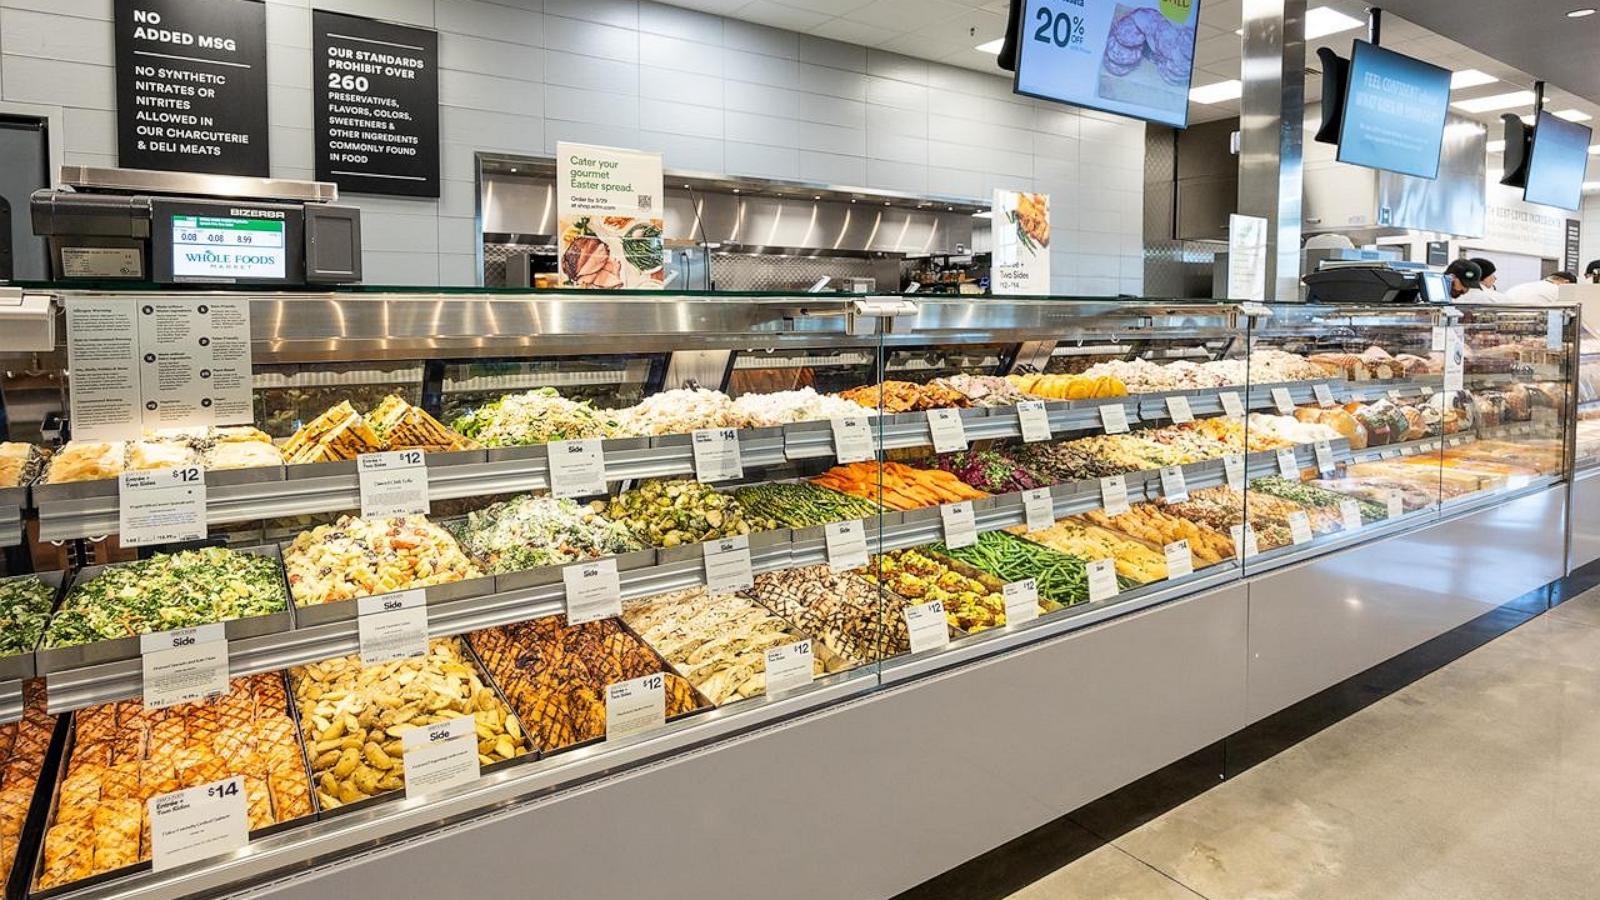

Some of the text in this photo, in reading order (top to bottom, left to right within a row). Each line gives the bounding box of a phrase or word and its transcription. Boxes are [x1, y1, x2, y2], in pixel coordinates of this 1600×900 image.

[133, 10, 160, 24] NO
[133, 26, 236, 51] ADDED MSG
[1070, 34, 1084, 43] OFF
[328, 46, 424, 69] OUR STANDARDS
[135, 65, 226, 85] NO SYNTHETIC
[328, 58, 415, 79] PROHIBIT OVER
[136, 81, 215, 98] NITRATES OR
[328, 73, 369, 92] 260
[136, 96, 191, 110] NITRITES
[328, 91, 400, 108] PRESERVATIVES,
[136, 110, 213, 126] ALLOWED IN
[329, 104, 412, 121] FLAVORS, COLORS,
[329, 116, 395, 130] SWEETENERS &
[136, 125, 249, 144] OUR CHARCUTERIE
[329, 128, 419, 144] OTHER INGREDIENTS
[137, 140, 221, 156] & DELI MEATS
[329, 140, 416, 156] COMMONLY FOUND
[329, 153, 369, 164] IN FOOD
[570, 155, 619, 169] Cater your
[570, 169, 610, 180] gourmet
[571, 179, 634, 192] Easter spread.
[230, 208, 285, 219] BIZERBA
[185, 250, 275, 265] WHOLE FOODS
[720, 430, 735, 440] $14
[400, 451, 420, 464] $12
[172, 468, 199, 482] $12
[383, 600, 402, 610] Side
[173, 636, 195, 647] Side
[794, 643, 809, 654] $12
[643, 676, 661, 690] $12
[430, 730, 450, 741] Side
[208, 782, 239, 798] $14
